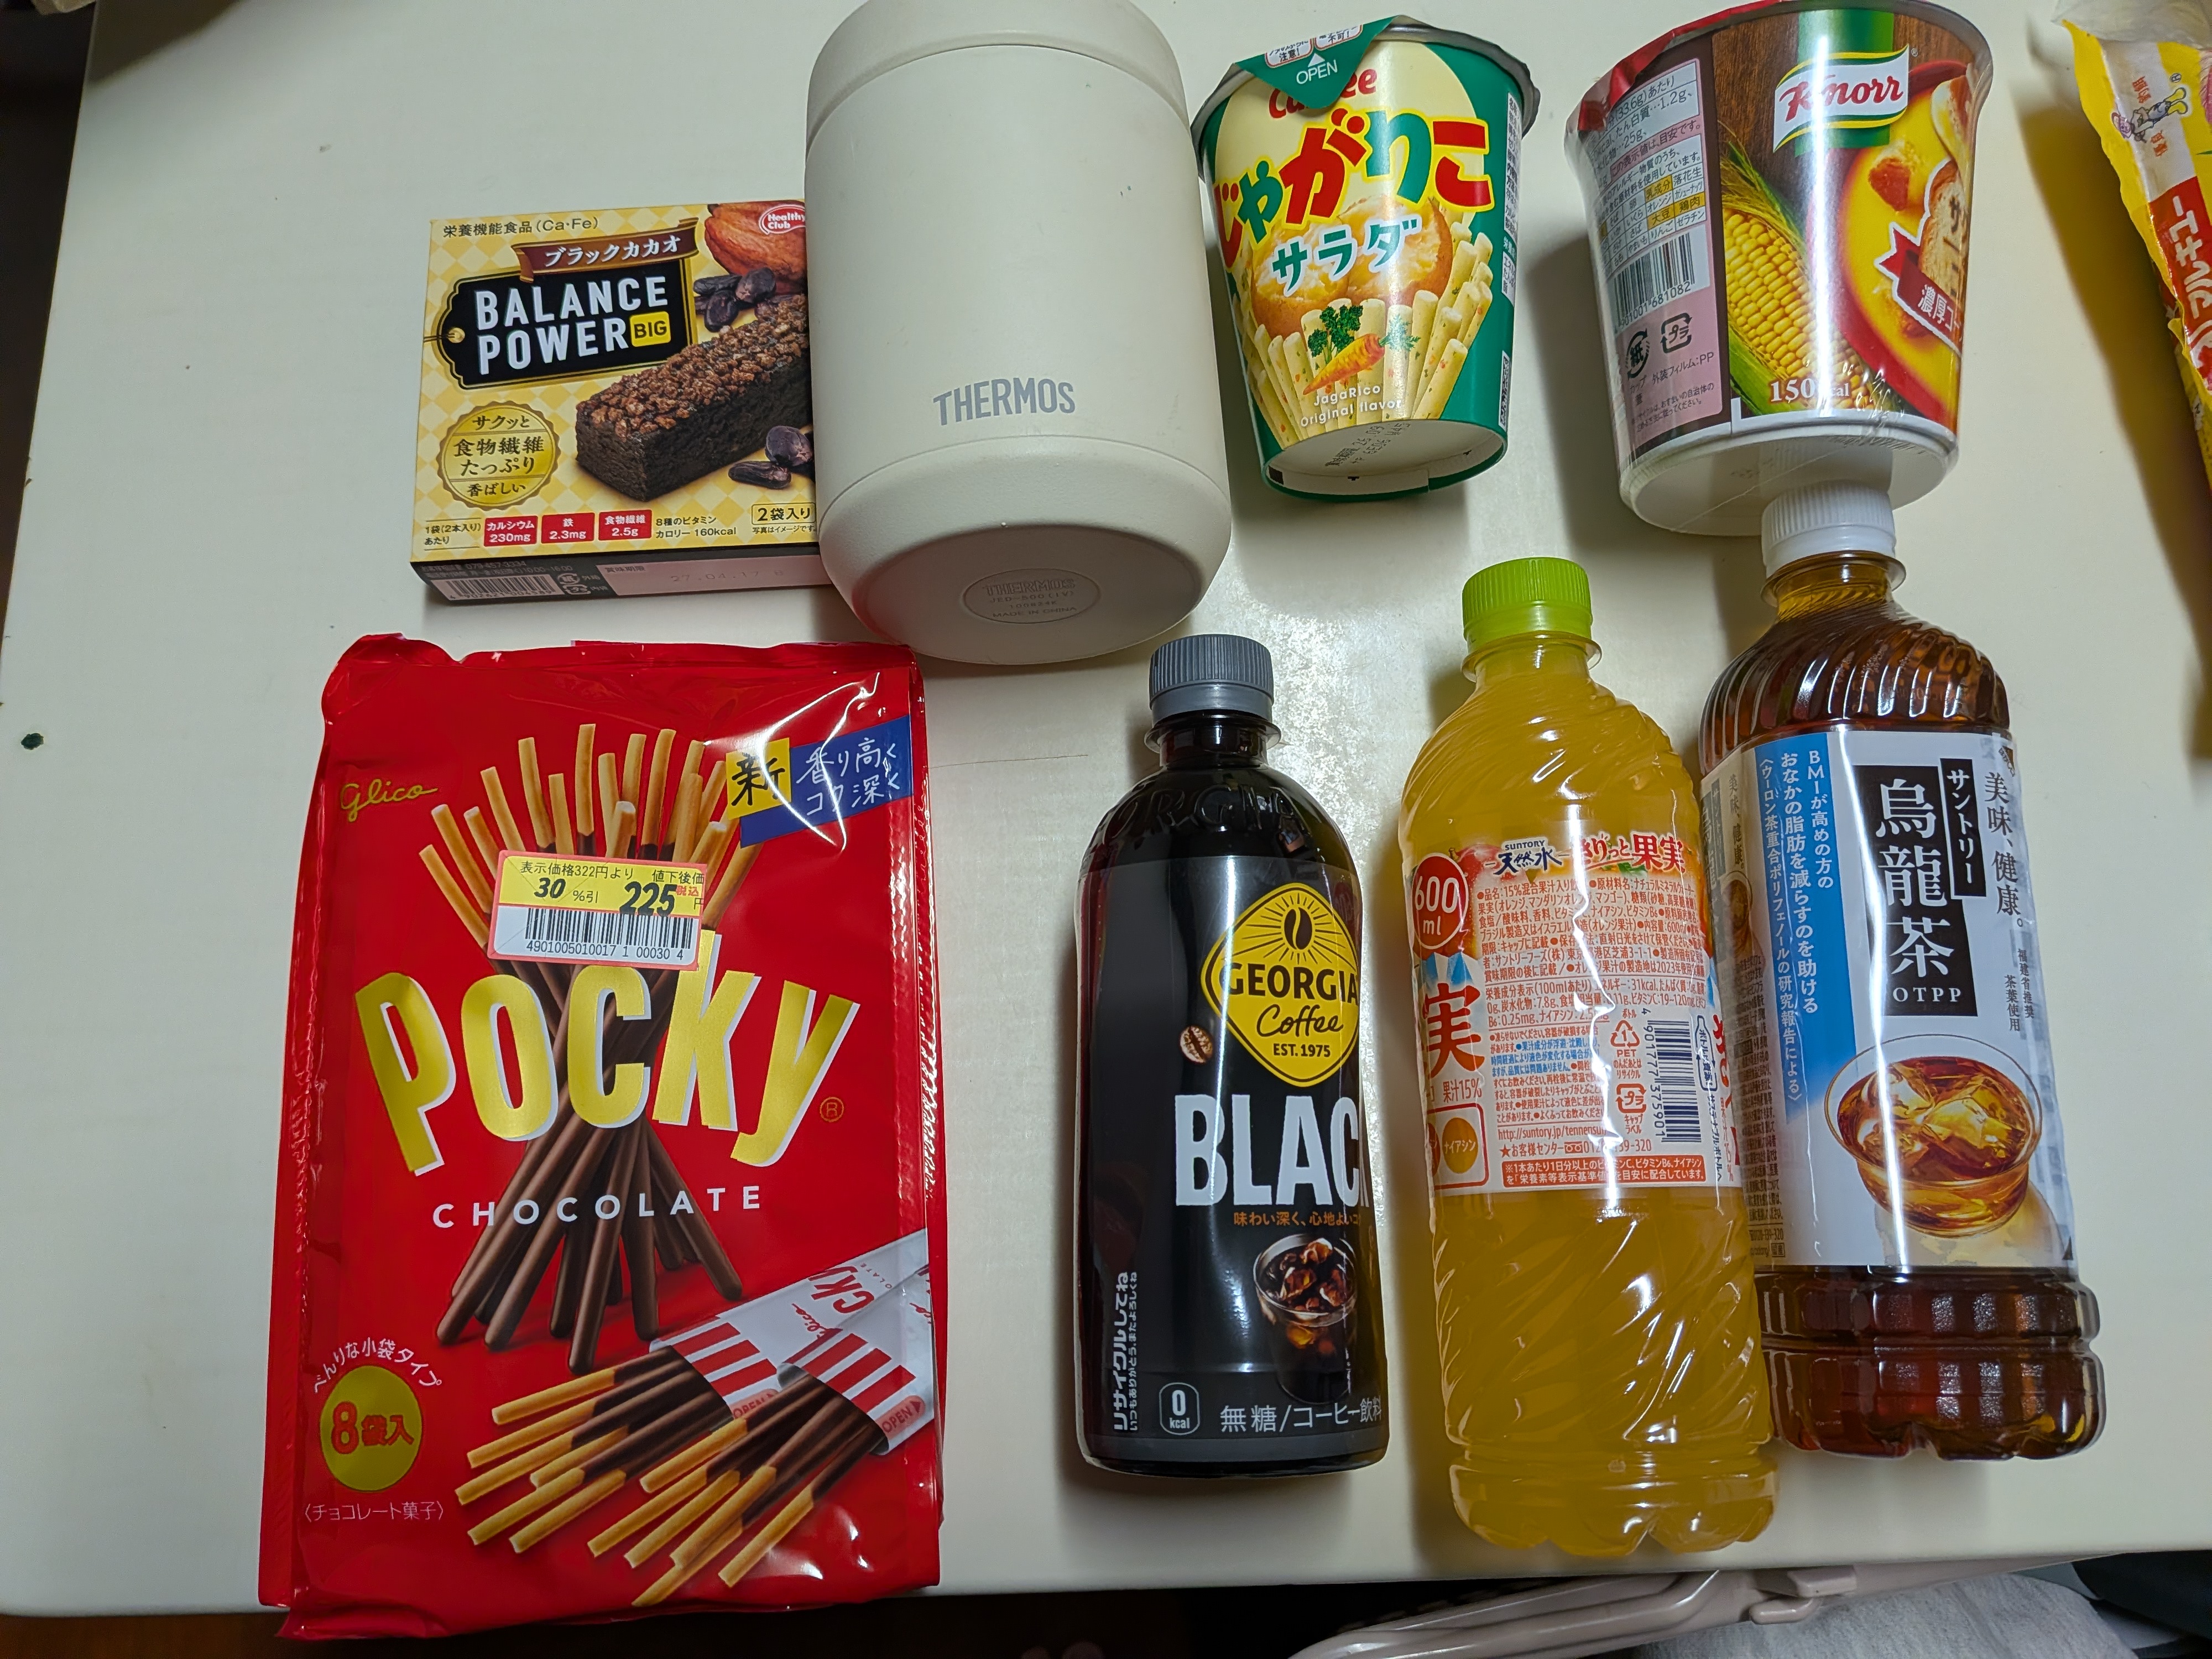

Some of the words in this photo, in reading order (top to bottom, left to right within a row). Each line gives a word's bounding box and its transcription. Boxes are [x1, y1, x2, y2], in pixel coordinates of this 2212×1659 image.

[1296, 62, 1339, 85] OPEN
[1269, 69, 1378, 119] Caee
[1779, 75, 1905, 122] Knorr
[767, 211, 805, 223] Healthy
[768, 221, 791, 230] Club
[1652, 208, 1670, 225] 大豆
[544, 234, 681, 268] ブラックカカオ
[1272, 220, 1417, 293] サラダ
[474, 276, 668, 331] BALANCE
[1651, 281, 1692, 307] 681082
[1669, 324, 1689, 344] プラ
[478, 318, 629, 375] POWER
[633, 319, 669, 340] BIG
[1770, 378, 1849, 404] 150cal
[932, 377, 1076, 426] THERMOS
[1359, 399, 1402, 414] flavor
[472, 414, 531, 431] サクッと
[452, 435, 545, 458] 食物繊維
[461, 457, 535, 477] たっぷり
[467, 482, 526, 497] 香ばしい
[604, 514, 646, 525] 食物繊維
[656, 516, 718, 527] 8種のビタミン
[757, 507, 811, 523] 2袋入り
[486, 520, 535, 531] カルシウム
[549, 530, 587, 540] 2.3mg
[612, 527, 639, 538] 2.5g
[656, 529, 691, 539] カロリー
[694, 527, 737, 537] 160kcal
[424, 536, 450, 546] あたり
[489, 533, 531, 544] 230mg
[982, 579, 1076, 596] THERMOS
[731, 750, 786, 807] 新
[1807, 750, 1834, 889] BMIが高めの方の
[1947, 770, 1973, 884] サントリー
[1504, 840, 1545, 851] SUNTORY
[1984, 771, 2024, 928] 美味、健康。
[520, 860, 634, 880] 表示価格322円より
[1494, 847, 1562, 875] 天然水
[1781, 752, 1819, 1014] おなかの脂肪を減らすのを助ける
[1876, 779, 1955, 978] 烏龍茶
[534, 877, 566, 899] 30
[573, 890, 599, 904] %引
[619, 881, 677, 917] 225
[676, 884, 700, 897] 税込
[1415, 875, 1460, 914] 600
[1423, 916, 1441, 936] ml
[526, 940, 617, 957] 4901005010017
[636, 947, 671, 960] 00030
[676, 949, 684, 961] 4
[1219, 962, 1359, 1006] GEORGIA
[1892, 987, 1961, 1002] OTPP
[2004, 974, 2021, 1032] 茶葉使用
[1256, 1004, 1344, 1037] Coffee
[1622, 1009, 1637, 1018] ボトル
[1614, 1059, 1642, 1068] のんだあとは
[1616, 1070, 1641, 1078] リサイクル
[1443, 1079, 1482, 1103] 果汁15%
[1625, 1091, 1644, 1105] プラ
[1624, 1114, 1643, 1124] キャップ
[1651, 1084, 1666, 1138] 375901
[1625, 1125, 1642, 1134] ラベル
[1443, 1140, 1476, 1155] ナイアシン
[1584, 1139, 1652, 1154] 01239-320
[432, 1185, 760, 1229] CHOCOLATE
[1234, 1211, 1361, 1227] 味わい深く、心地よいコ
[1113, 1271, 1128, 1431] リサイクルしてね
[1171, 1389, 1186, 1416] 0
[332, 1401, 415, 1455] 8袋入
[881, 1408, 913, 1433] OPEN
[1169, 1417, 1191, 1430] kcal
